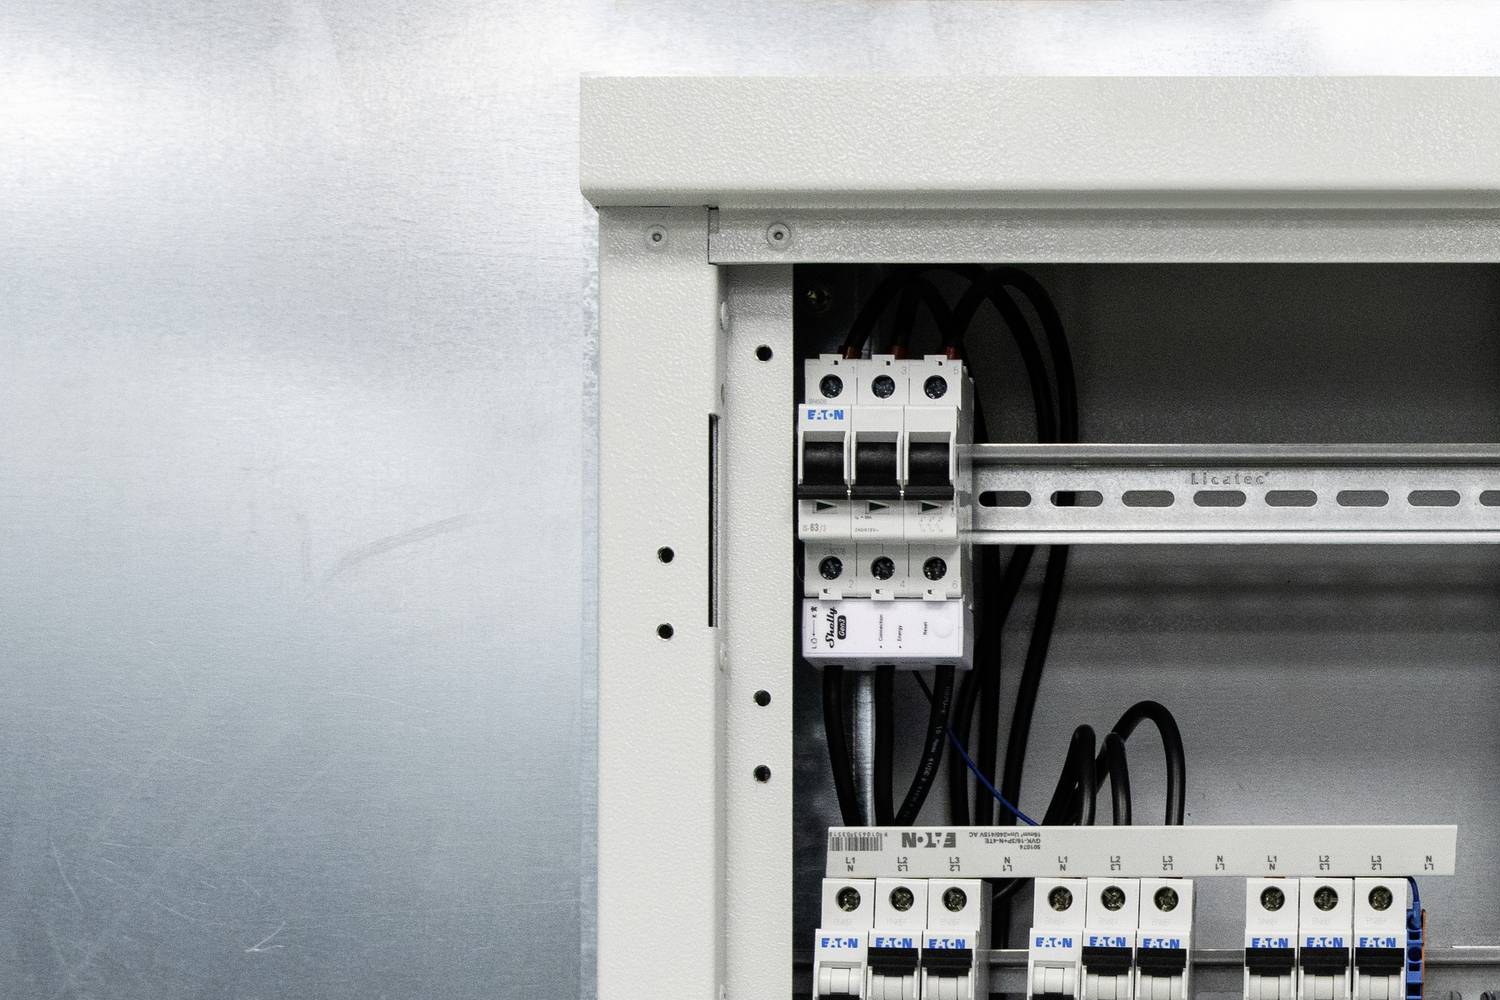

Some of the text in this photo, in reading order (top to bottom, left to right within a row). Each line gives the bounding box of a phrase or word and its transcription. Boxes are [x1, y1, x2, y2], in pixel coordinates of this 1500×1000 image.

[825, 607, 837, 648] Shelly
[838, 616, 846, 638] Gen3
[1319, 855, 1330, 863] L2
[1371, 855, 1382, 863] L3
